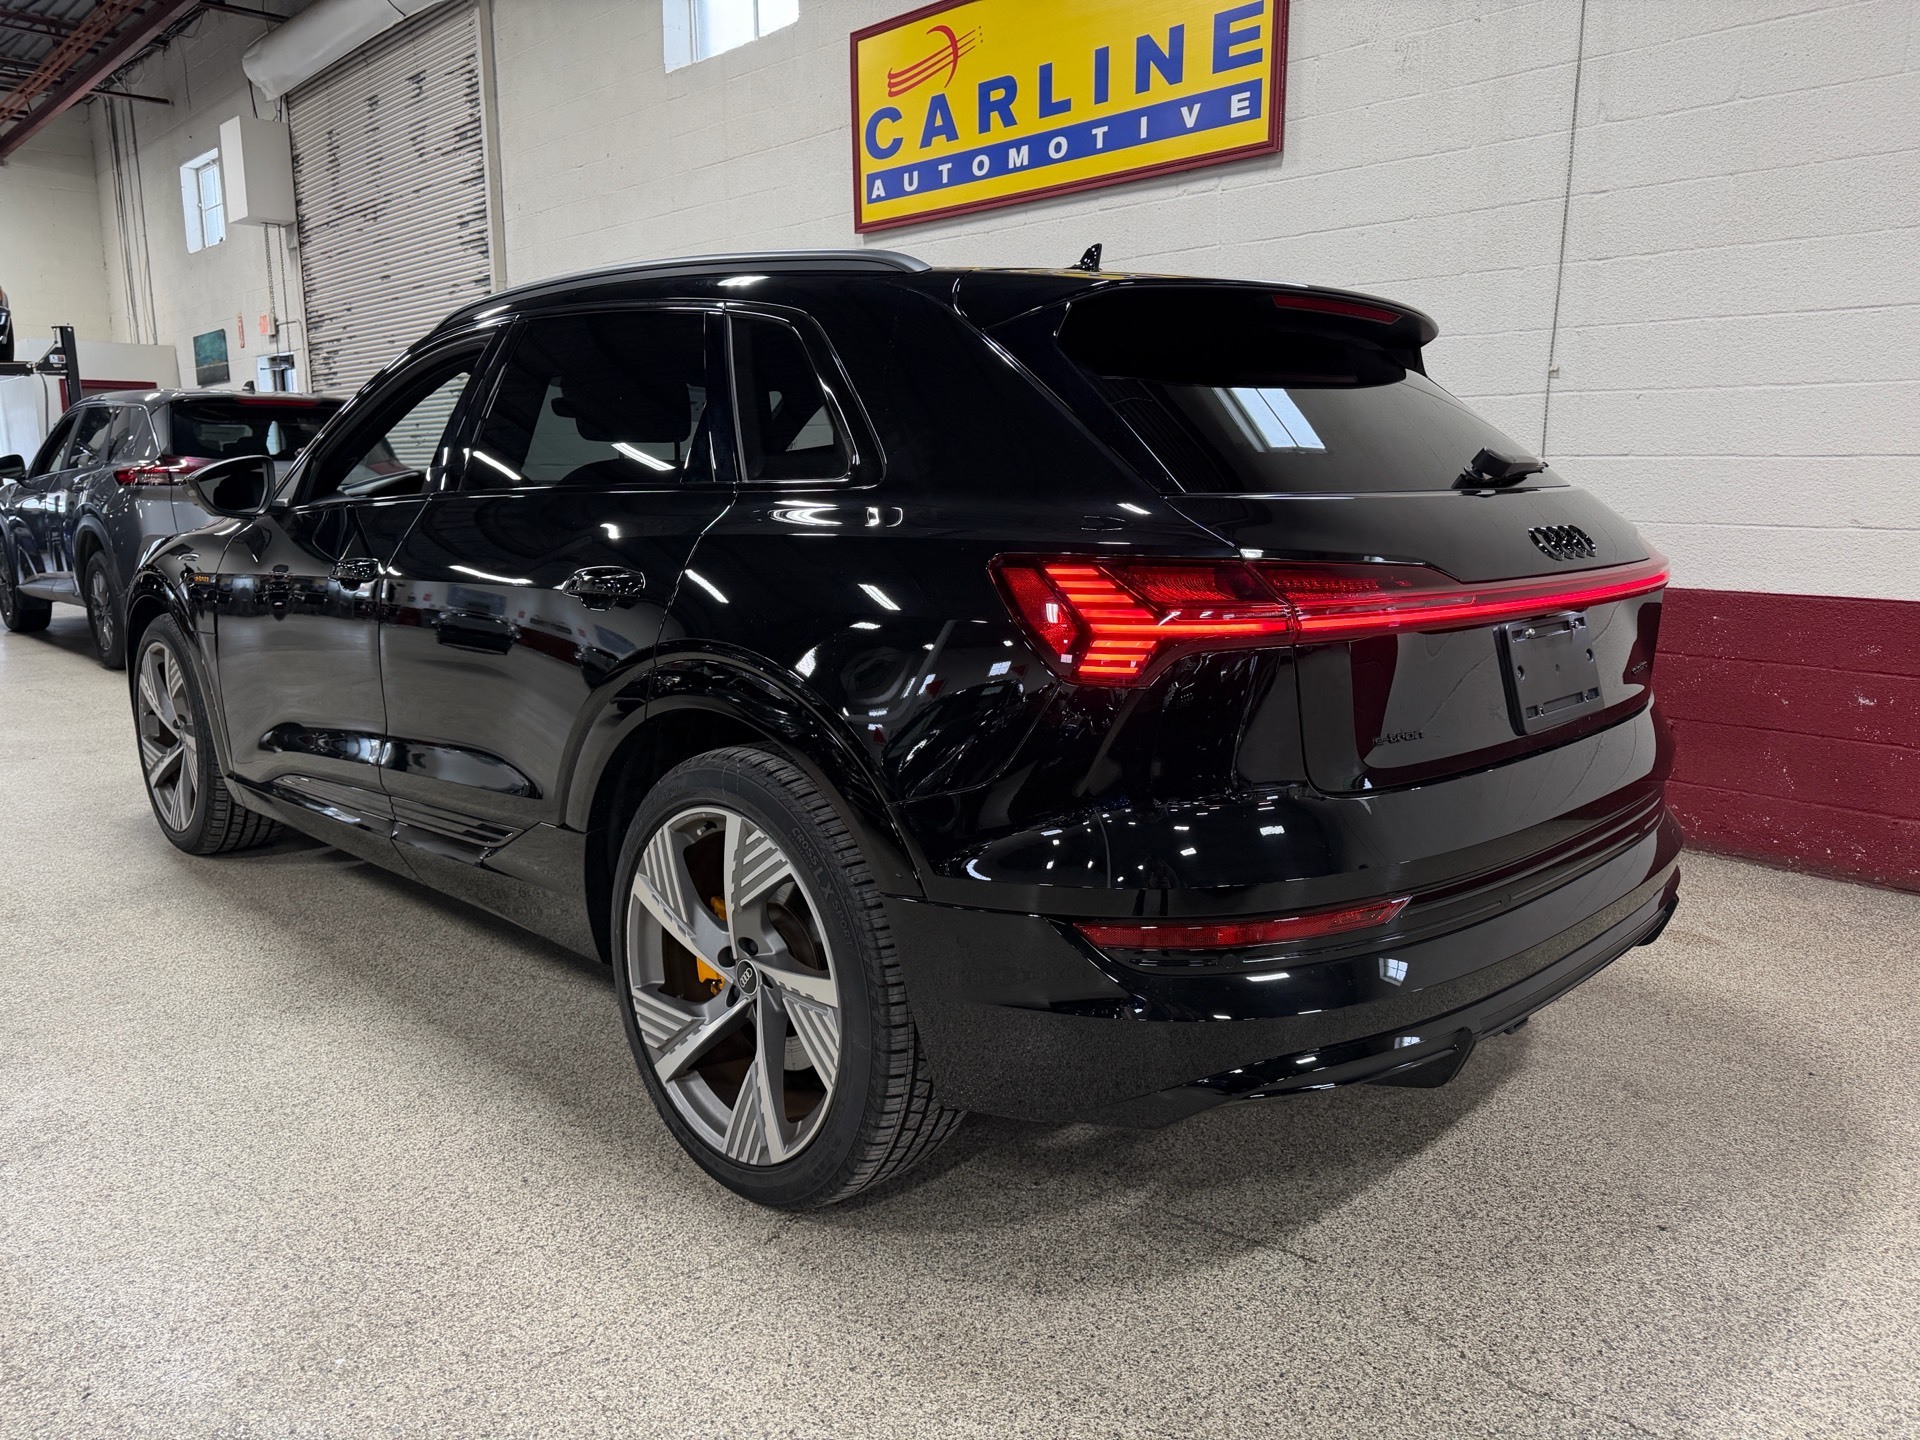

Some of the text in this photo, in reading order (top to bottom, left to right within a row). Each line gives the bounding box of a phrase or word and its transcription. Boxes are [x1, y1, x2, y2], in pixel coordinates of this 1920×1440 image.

[865, 0, 1264, 160] CARLINE
[871, 91, 1251, 199] AUTOMOTIVE
[791, 827, 819, 866] CROSS
